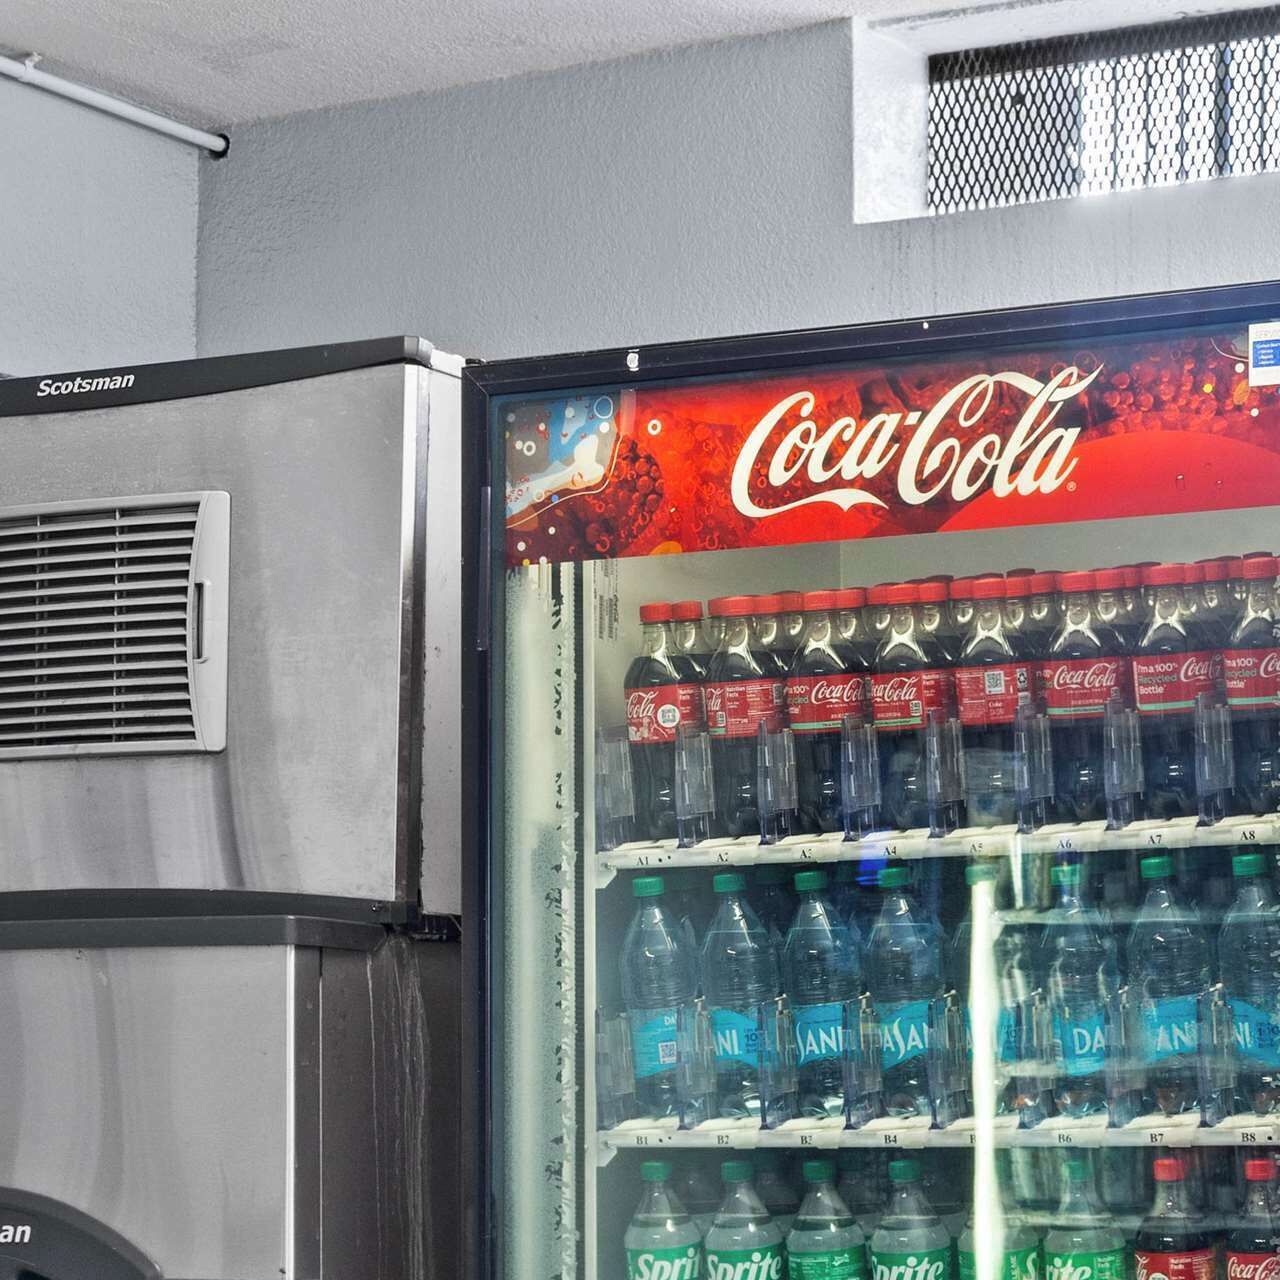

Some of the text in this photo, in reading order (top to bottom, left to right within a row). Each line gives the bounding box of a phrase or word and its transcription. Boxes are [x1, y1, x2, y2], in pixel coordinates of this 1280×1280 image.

[36, 371, 136, 398] Scotsman
[730, 362, 1105, 520] Coca-Cola
[1054, 663, 1117, 690] Coca-Cola
[1147, 834, 1162, 845] A7
[1240, 830, 1255, 840] A8
[1056, 839, 1072, 849] A6
[636, 1135, 648, 1145] B1
[884, 1134, 897, 1144] B4
[1058, 1134, 1071, 1144] B6
[1150, 1133, 1163, 1143] B7
[1241, 1133, 1255, 1142] B8
